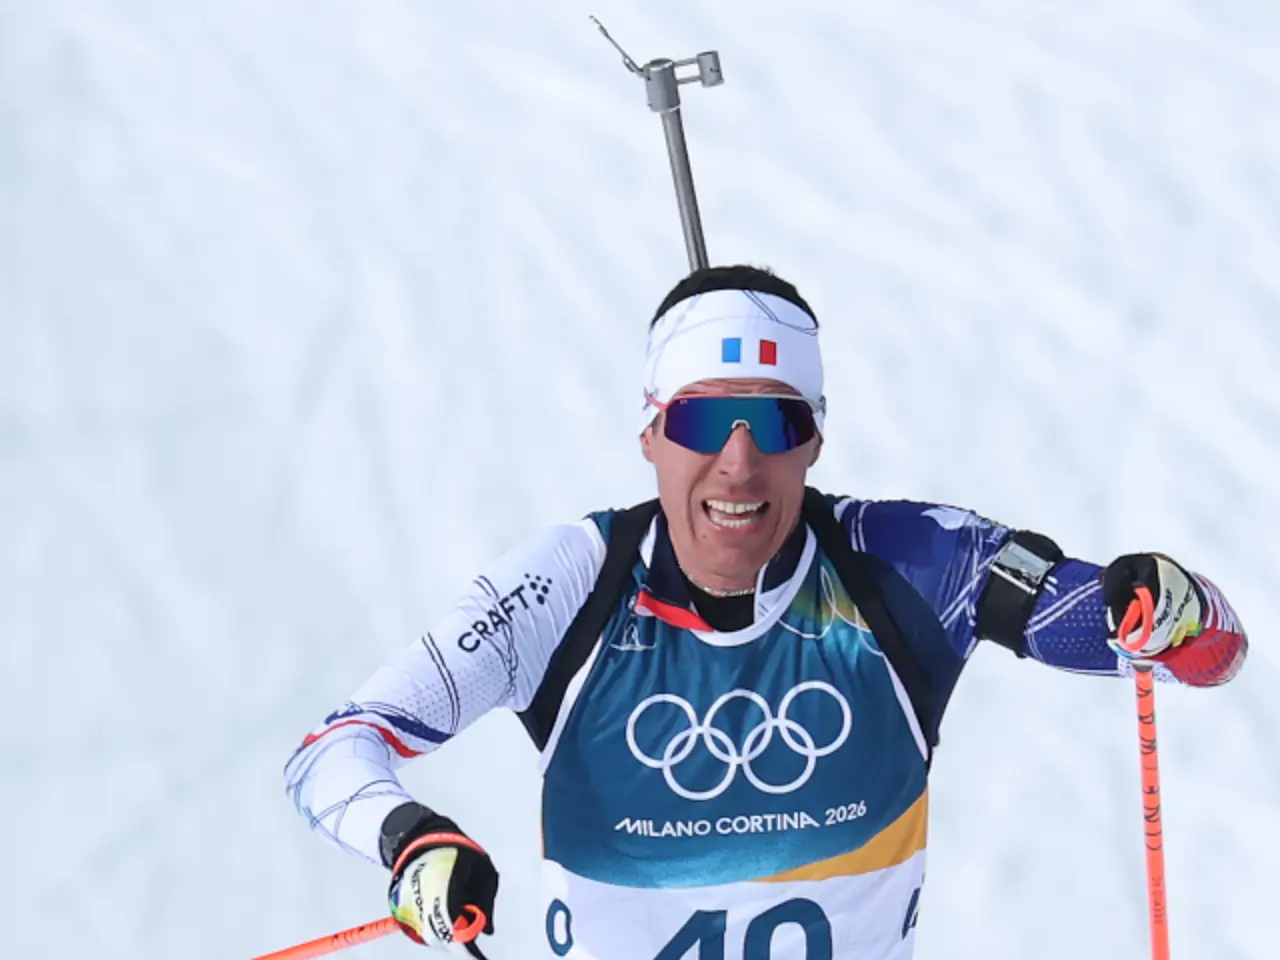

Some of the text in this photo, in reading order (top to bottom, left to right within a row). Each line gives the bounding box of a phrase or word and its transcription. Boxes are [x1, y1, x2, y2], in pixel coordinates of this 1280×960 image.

[458, 584, 529, 652] CRAFT
[614, 800, 867, 838] MILANO CORTINA 2026
